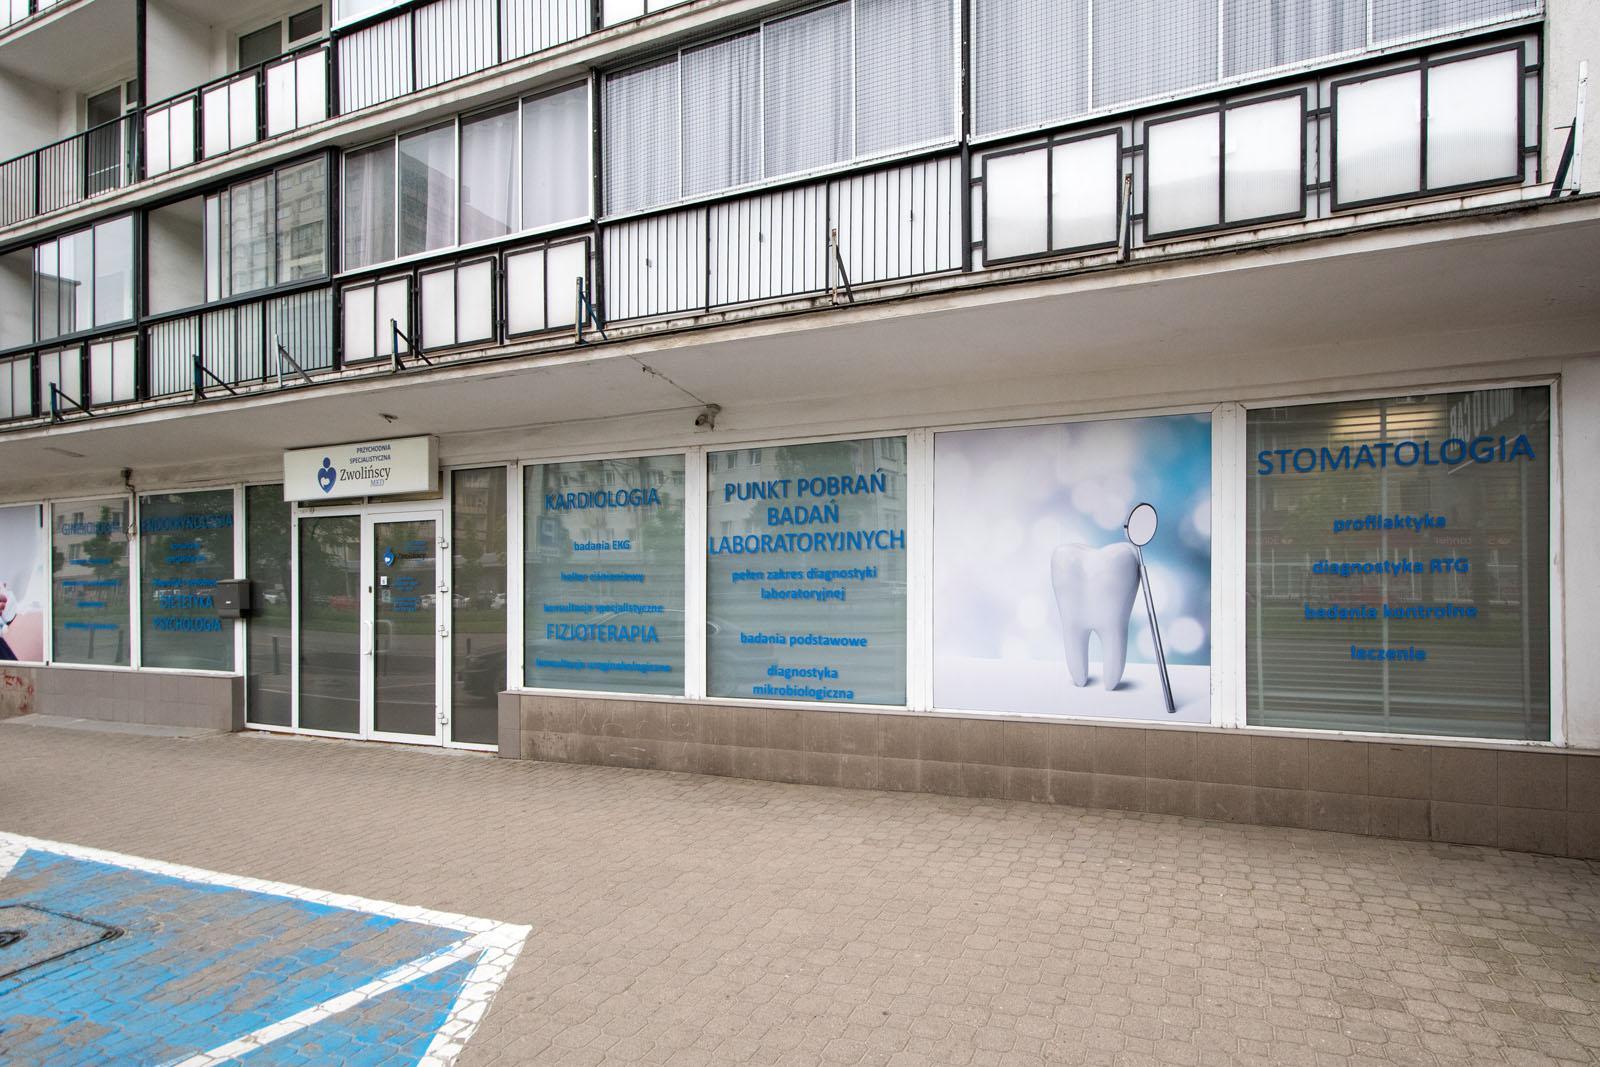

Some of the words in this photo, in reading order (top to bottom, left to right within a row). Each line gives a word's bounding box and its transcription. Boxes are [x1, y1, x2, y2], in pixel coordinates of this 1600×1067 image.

[356, 444, 392, 454] PRZYCHODNIA
[1257, 434, 1536, 475] STOMATOLOGIA
[349, 454, 392, 465] SPECJALISTYCZNA
[339, 465, 392, 481] Zwolińscy
[724, 479, 792, 502] PUNKT
[797, 467, 886, 498] POBRAŃ
[545, 487, 659, 511] KARDIOLOGIA
[767, 498, 839, 526] BADAŃ
[1334, 513, 1447, 534] profilaktyka
[573, 540, 610, 552] badania
[611, 539, 631, 551] EKG
[709, 528, 905, 555] LABORATORYJNYCH
[731, 568, 764, 584] pełen
[766, 567, 804, 581] zakres
[805, 565, 877, 583] diagnostyki
[1312, 558, 1424, 577] diagnostyka
[1430, 557, 1469, 573] RTG
[159, 594, 213, 609] DIETETYKA
[760, 586, 845, 602] laboratoryjnej
[1304, 604, 1377, 619] badania
[1383, 603, 1478, 619] kontrolne
[152, 616, 222, 632] PSYCHOLOGIA
[546, 623, 659, 643] FIZJOTERAPIA
[740, 631, 787, 645] badania
[788, 633, 868, 648] podstawowe
[1351, 644, 1427, 661] leczenie
[766, 664, 839, 681] diagnostyka
[752, 683, 854, 701] mikrobiologiczna
